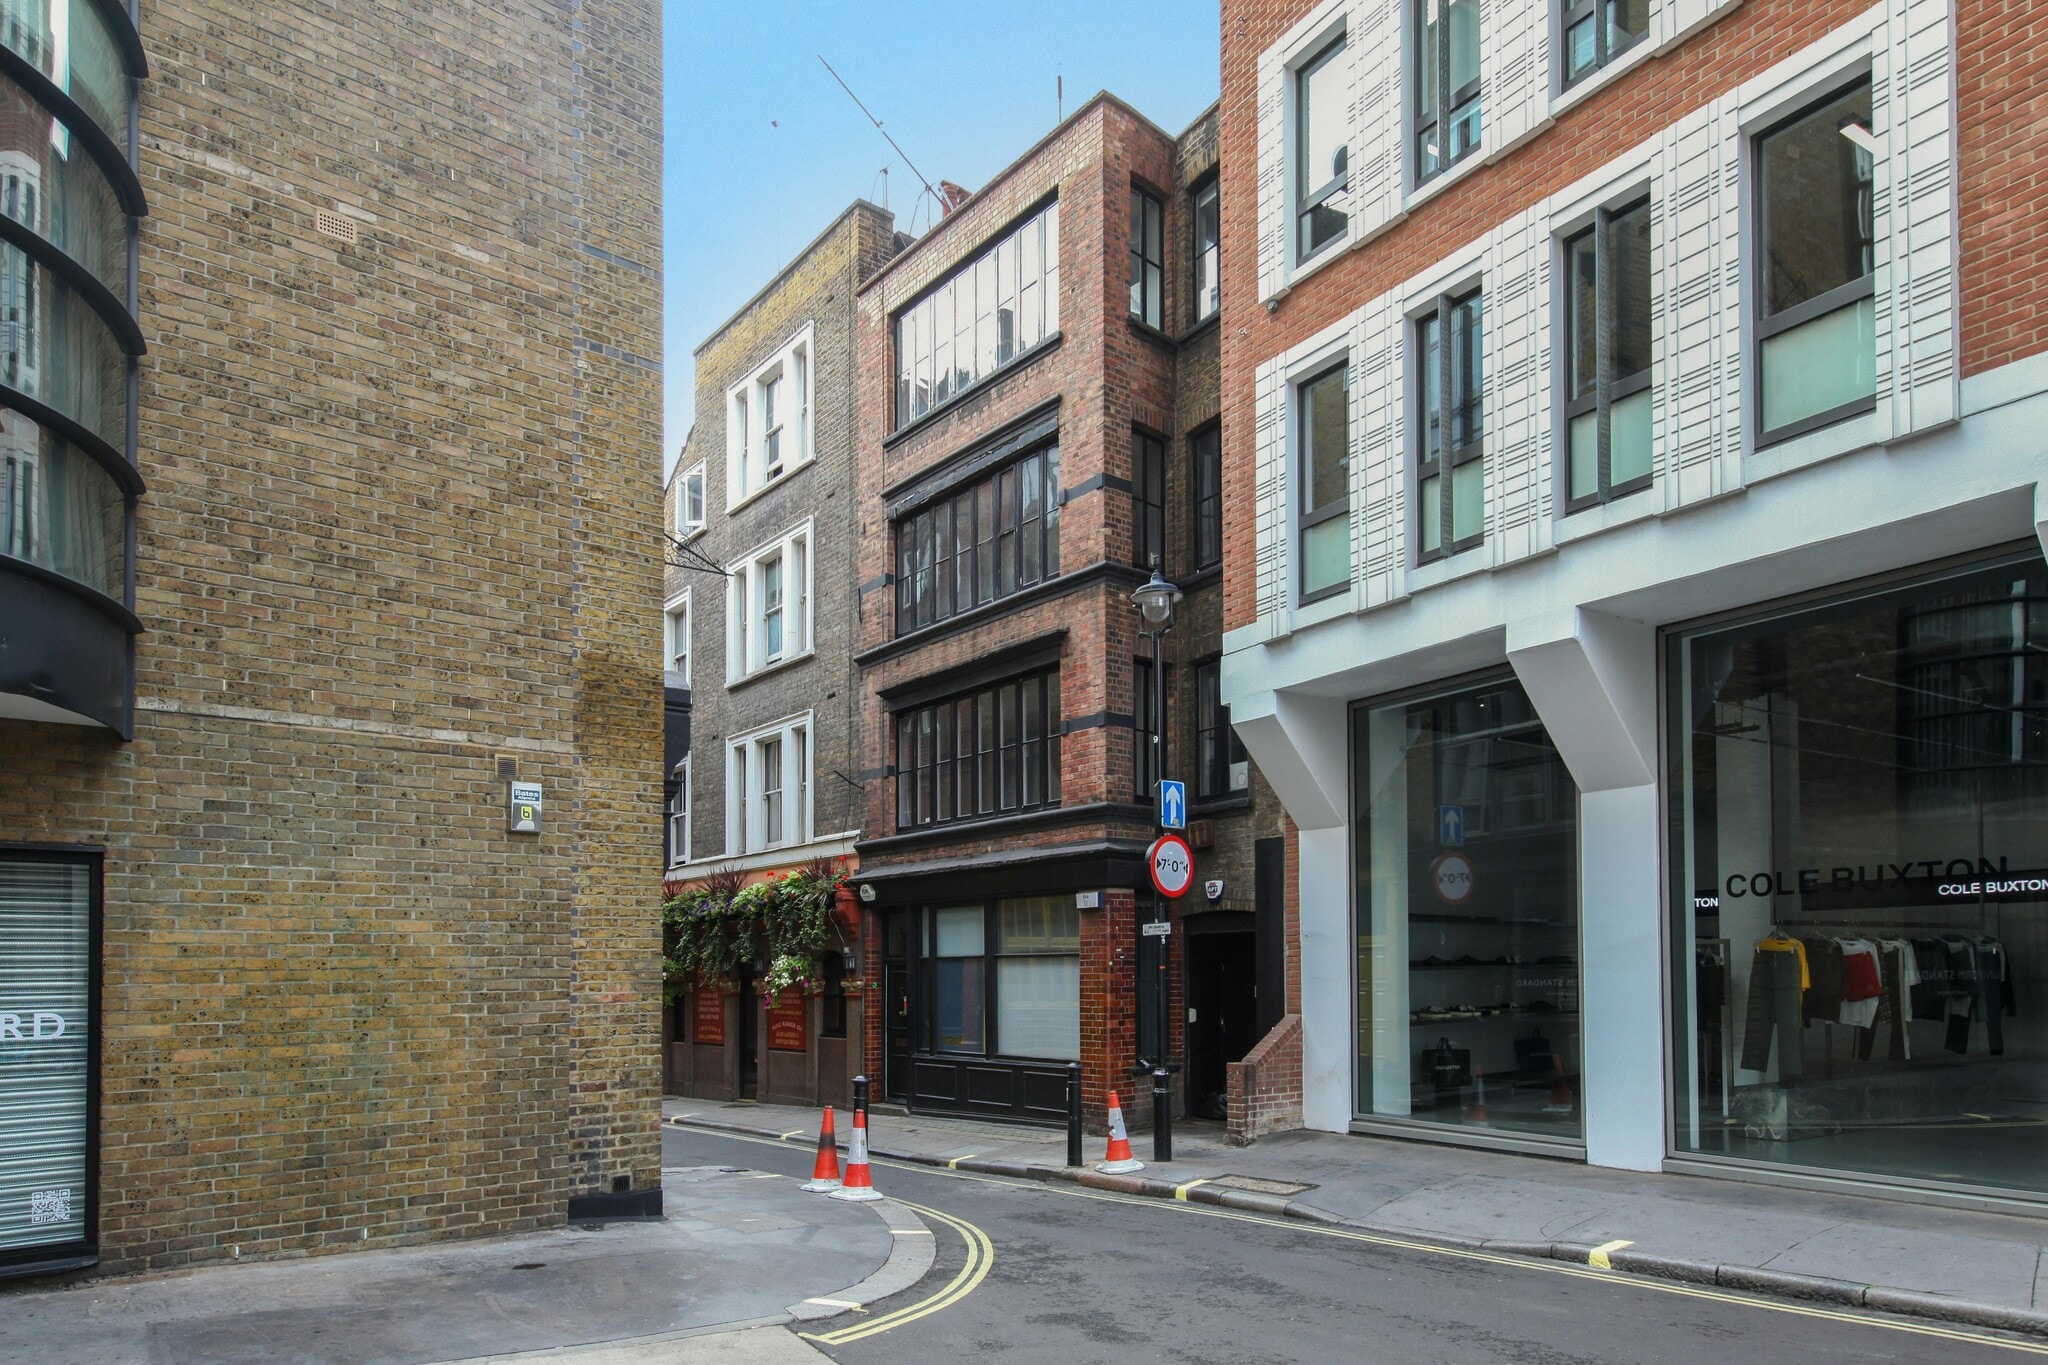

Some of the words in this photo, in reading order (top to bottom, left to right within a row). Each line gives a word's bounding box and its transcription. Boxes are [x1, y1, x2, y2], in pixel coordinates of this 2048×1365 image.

[1153, 735, 1159, 743] 9
[1726, 869, 1819, 898] COLE
[1832, 856, 2008, 893] BUXTON
[1938, 882, 1981, 895] COLE
[1694, 897, 1718, 908] TON
[0, 1012, 65, 1040] RD
